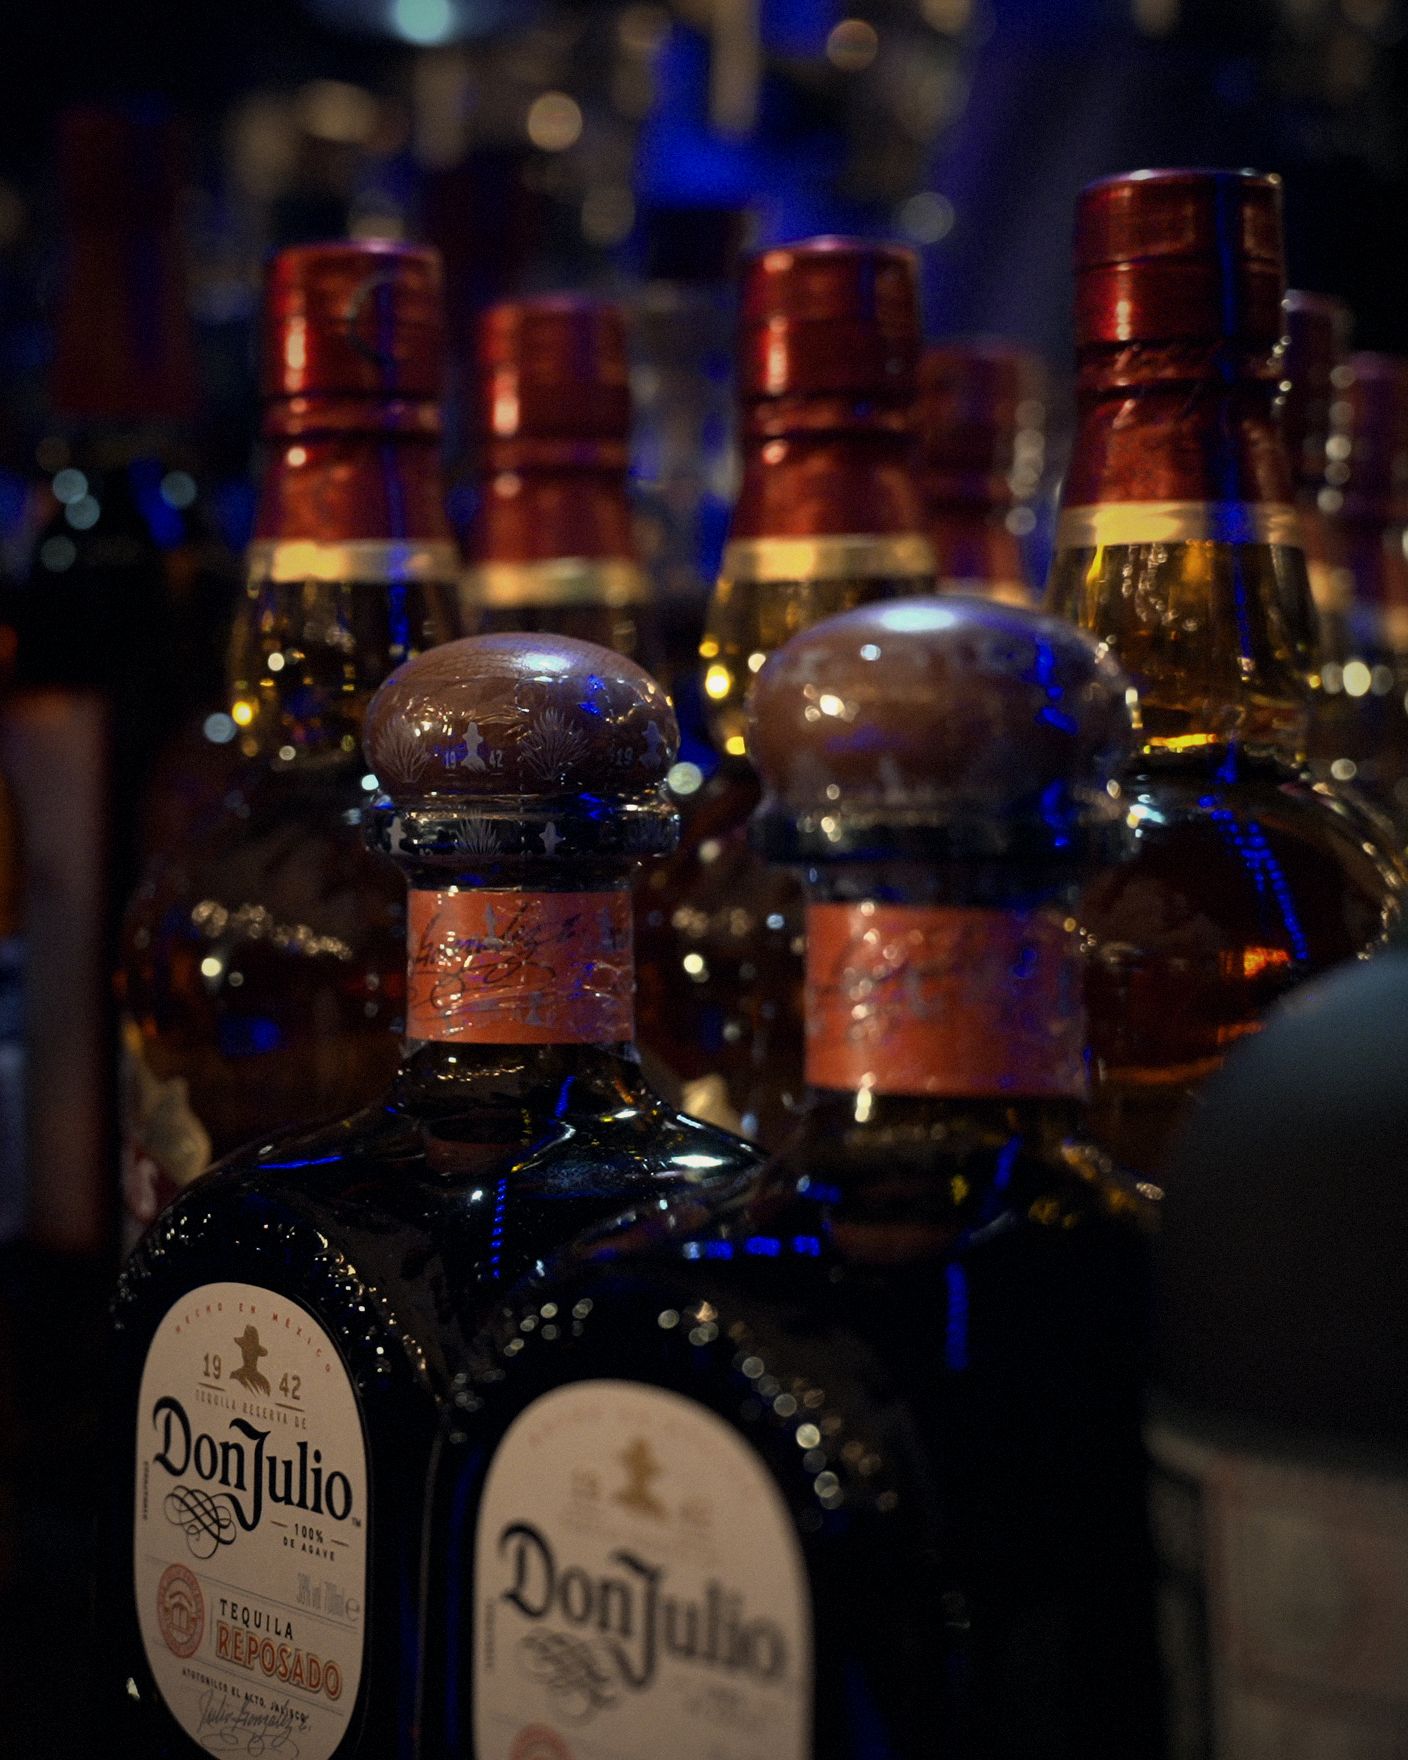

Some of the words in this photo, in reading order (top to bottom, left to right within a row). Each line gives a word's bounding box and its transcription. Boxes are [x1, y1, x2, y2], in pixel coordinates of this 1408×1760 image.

[489, 750, 504, 768] 42
[175, 1302, 223, 1334] HECHO
[238, 1303, 256, 1314] EN
[203, 1352, 222, 1380] 19
[278, 1372, 302, 1400] 42
[195, 1389, 237, 1411] TEQUILA
[243, 1402, 289, 1425] RESERVA
[294, 1418, 307, 1430] DE
[283, 1536, 295, 1549] DE
[301, 1542, 336, 1562] AGAVE
[294, 1523, 324, 1544] 100%
[219, 1598, 294, 1641] TEQUILA
[216, 1620, 344, 1701] REPOSADO
[181, 1667, 229, 1694] ATOTONILCO
[231, 1686, 241, 1699] EL
